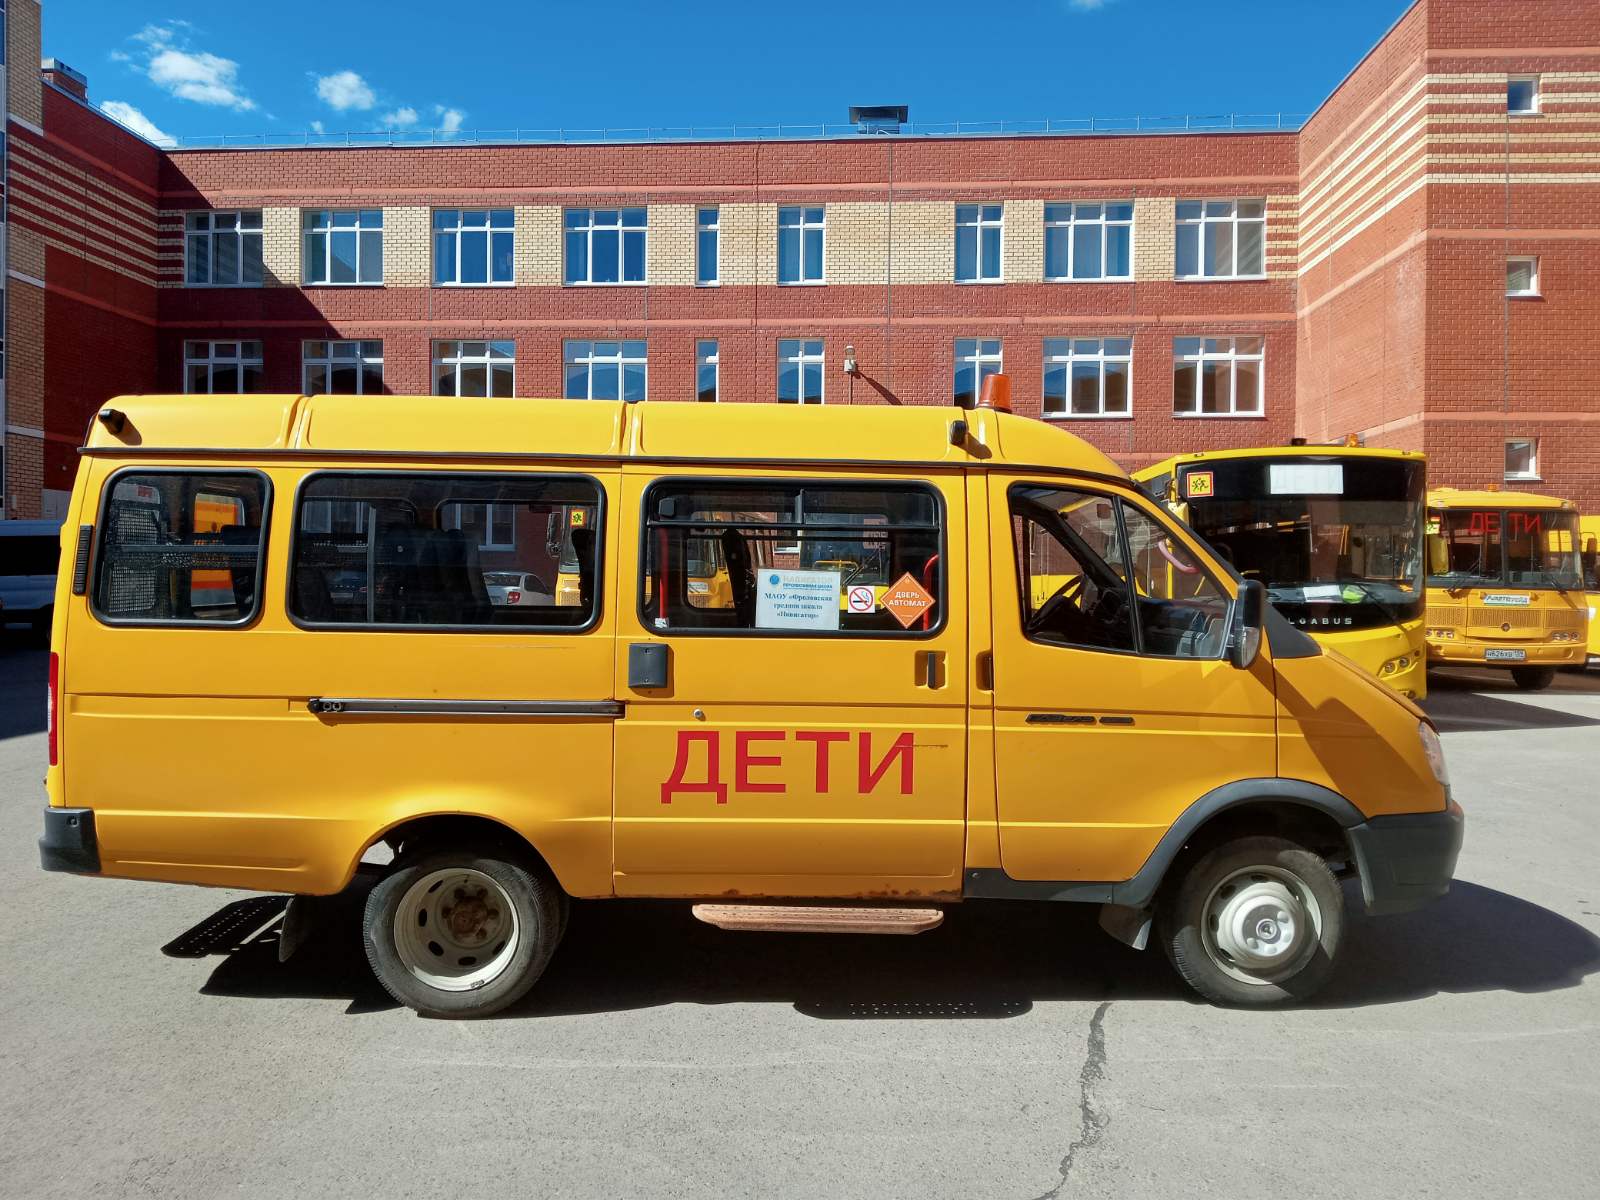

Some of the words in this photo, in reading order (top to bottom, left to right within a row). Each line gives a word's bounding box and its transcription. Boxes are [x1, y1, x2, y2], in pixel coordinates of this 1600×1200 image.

[1468, 512, 1541, 535] ДЕТИ
[895, 591, 920, 599] ДВЕРЬ
[888, 599, 926, 607] АВТОМАТ
[661, 730, 914, 804] ДЕТИ
